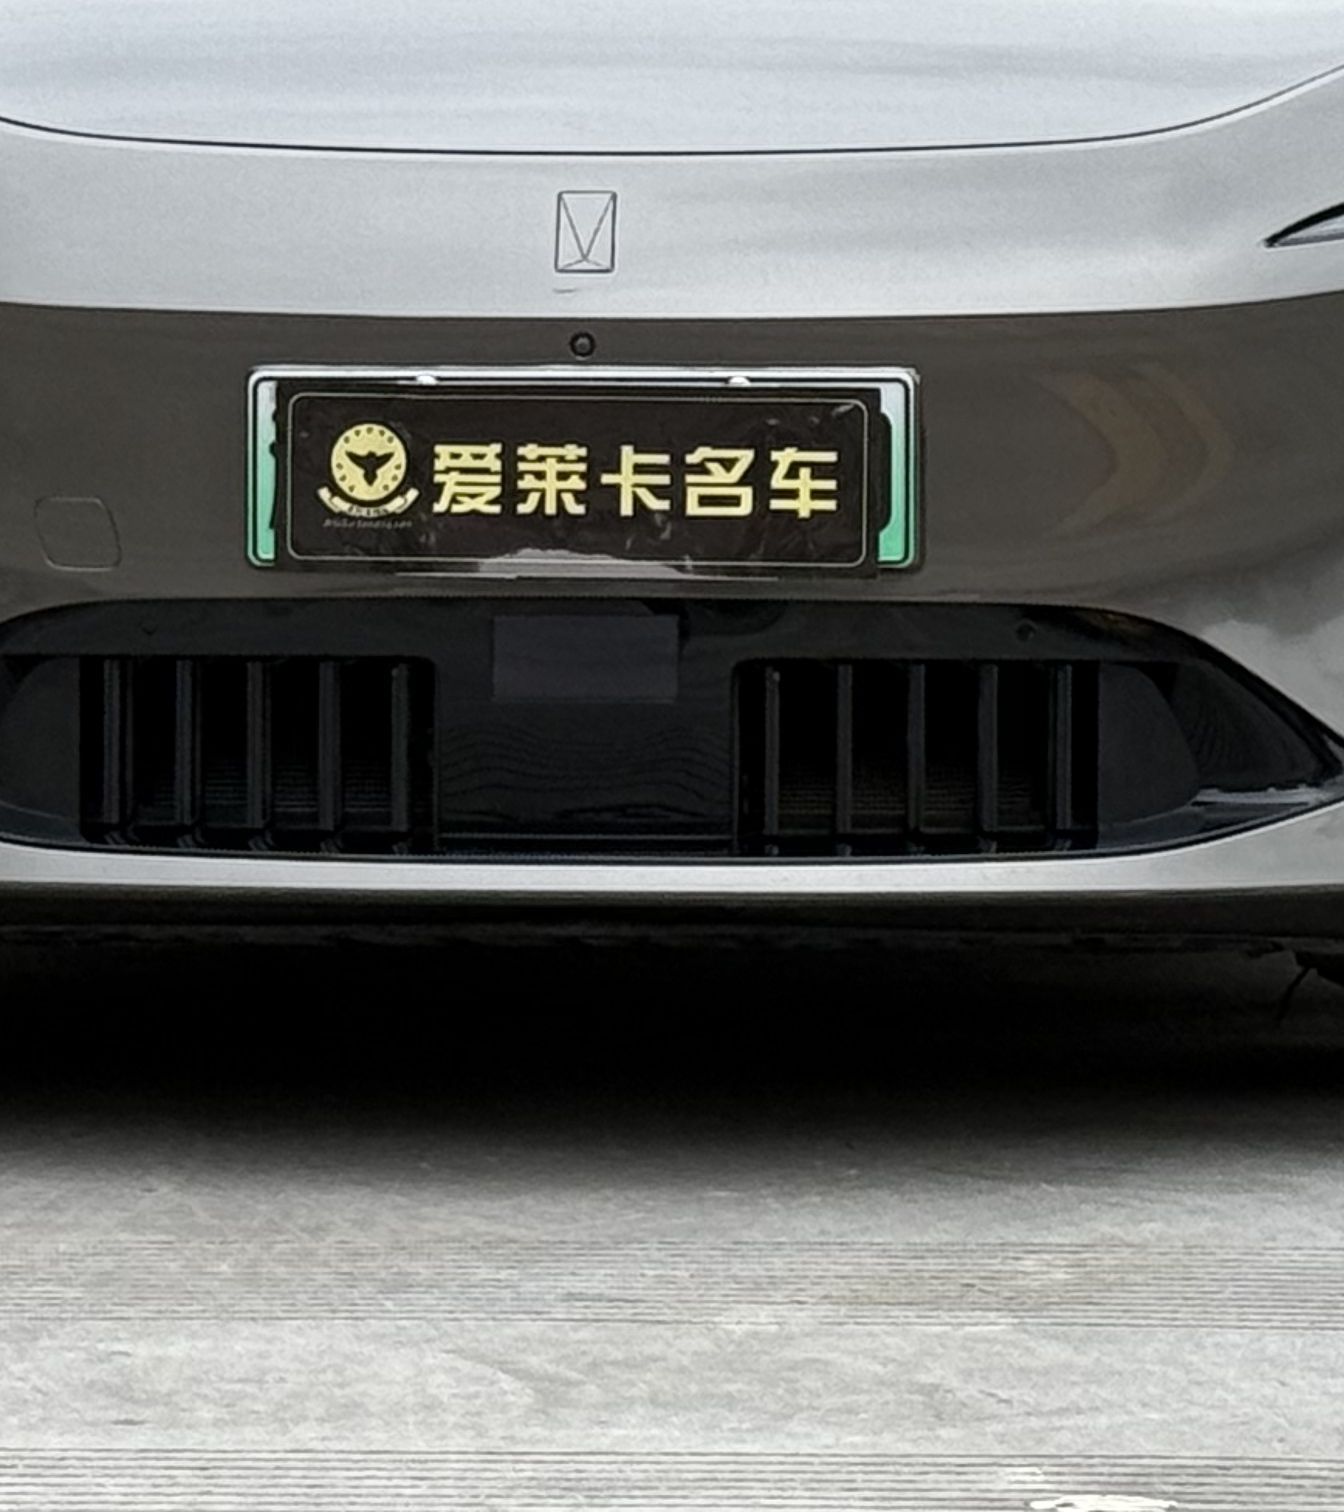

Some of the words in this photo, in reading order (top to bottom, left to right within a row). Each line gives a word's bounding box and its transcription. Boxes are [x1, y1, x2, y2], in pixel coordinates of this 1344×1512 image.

[432, 442, 838, 518] 爱莱卡名车
